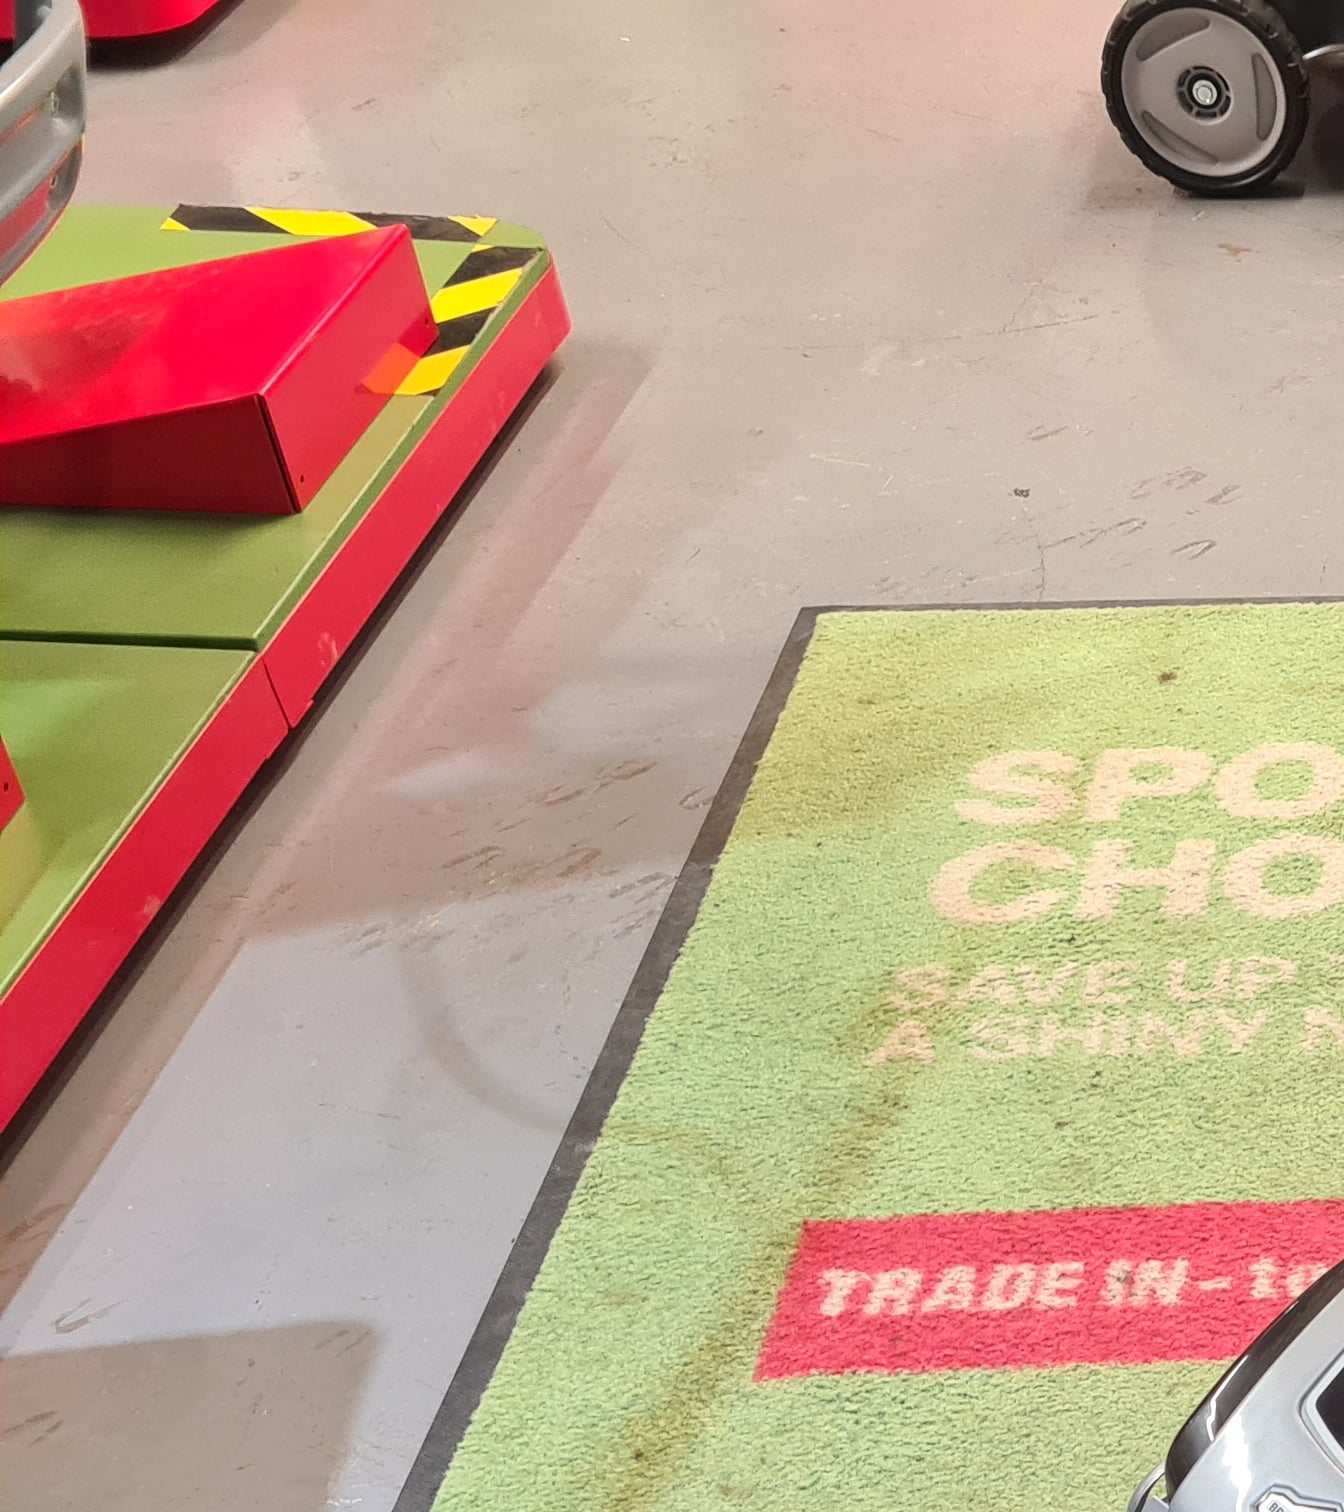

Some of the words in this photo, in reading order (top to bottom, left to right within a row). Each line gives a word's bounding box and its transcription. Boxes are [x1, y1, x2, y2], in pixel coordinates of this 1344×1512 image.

[887, 959, 1142, 1010] SAVE
[1166, 954, 1299, 1003] UP
[863, 1016, 937, 1067] A
[963, 1007, 1270, 1060] SHINY
[815, 1259, 1086, 1318] TRADE
